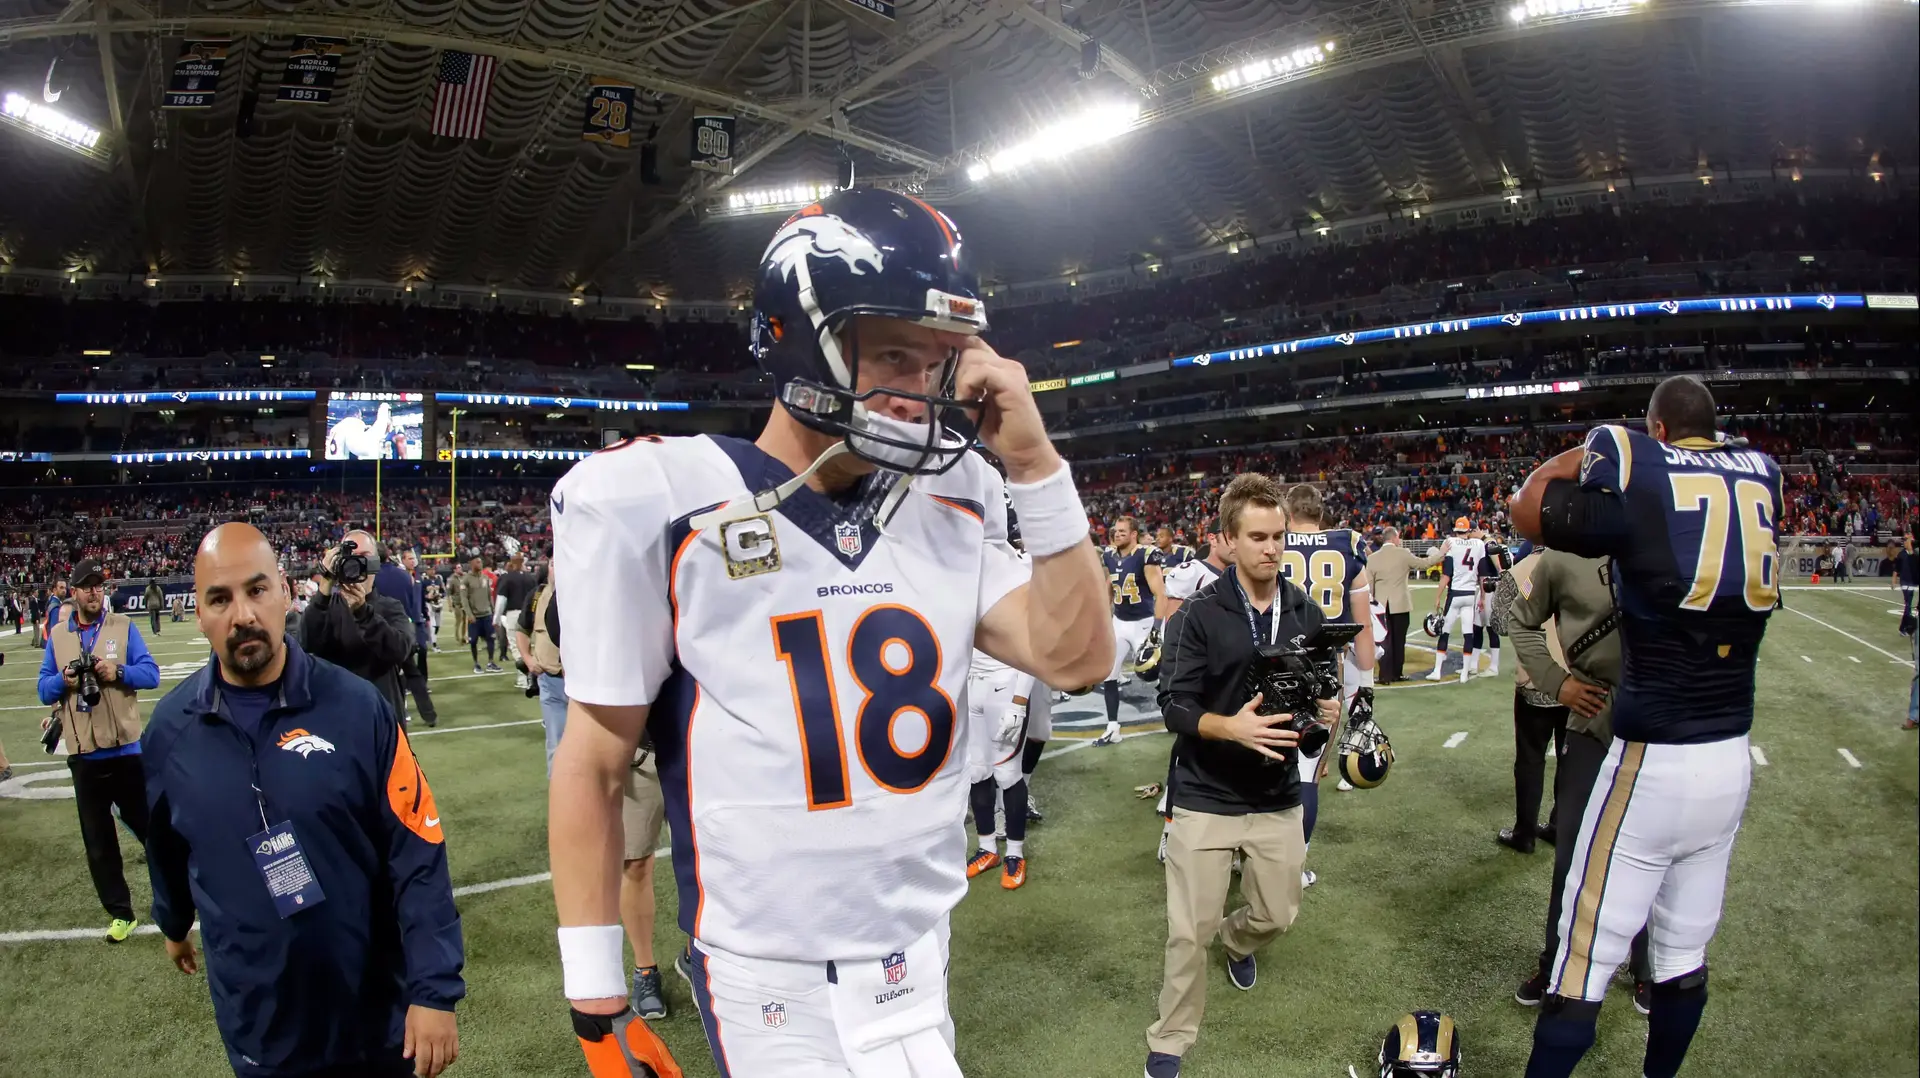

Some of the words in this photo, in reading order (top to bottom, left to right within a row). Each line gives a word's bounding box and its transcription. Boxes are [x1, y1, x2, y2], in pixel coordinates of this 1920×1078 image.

[288, 64, 336, 73] CHAMPIONS
[173, 95, 203, 105] 1945
[290, 89, 319, 100] 1951
[602, 89, 621, 100] FAULK
[590, 97, 627, 129] 28
[704, 119, 723, 129] BRUCE
[697, 126, 729, 157] 80
[1031, 381, 1063, 391] ERSON
[1658, 441, 1755, 473] SAFFOLD
[725, 518, 773, 561] C
[841, 536, 859, 550] NFL
[1287, 533, 1328, 546] DAVIS
[1668, 472, 1776, 612] 76
[1462, 548, 1474, 571] 4
[1799, 558, 1814, 572] 89
[1866, 558, 1879, 572] 77
[816, 582, 894, 598] BRONCOS
[1109, 573, 1142, 605] 54
[128, 595, 146, 609] OU
[769, 603, 956, 811] 18
[270, 833, 296, 852] RAMS
[886, 963, 907, 983] NFL
[875, 987, 910, 1005] Wilson
[765, 1012, 785, 1026] NFL
